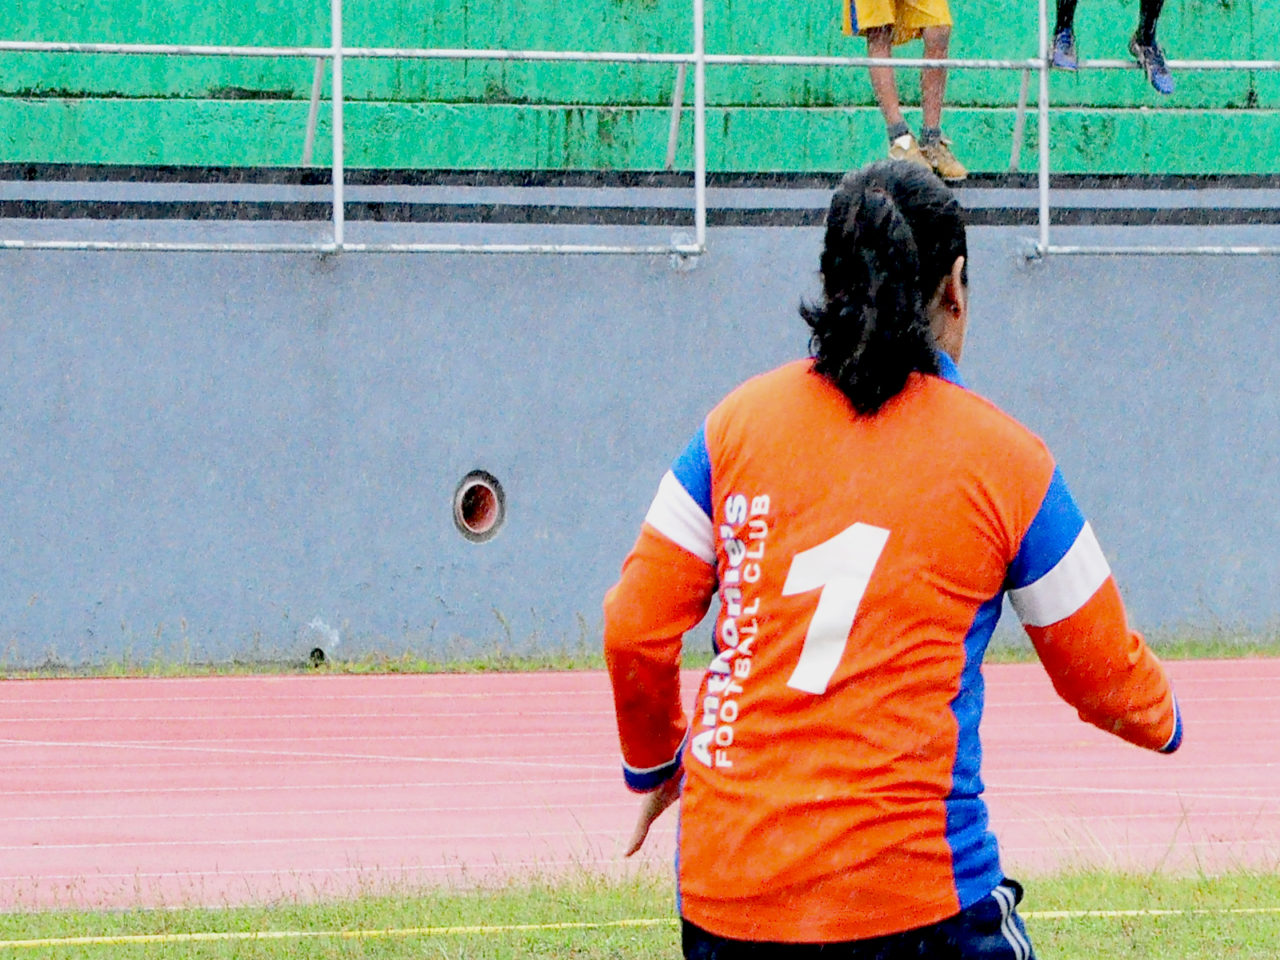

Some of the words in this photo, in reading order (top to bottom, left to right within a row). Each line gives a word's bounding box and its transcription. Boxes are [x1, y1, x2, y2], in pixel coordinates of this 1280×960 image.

[715, 597, 760, 767] FOOTBALL
[743, 494, 771, 584] CLUB
[781, 521, 891, 695] 1
